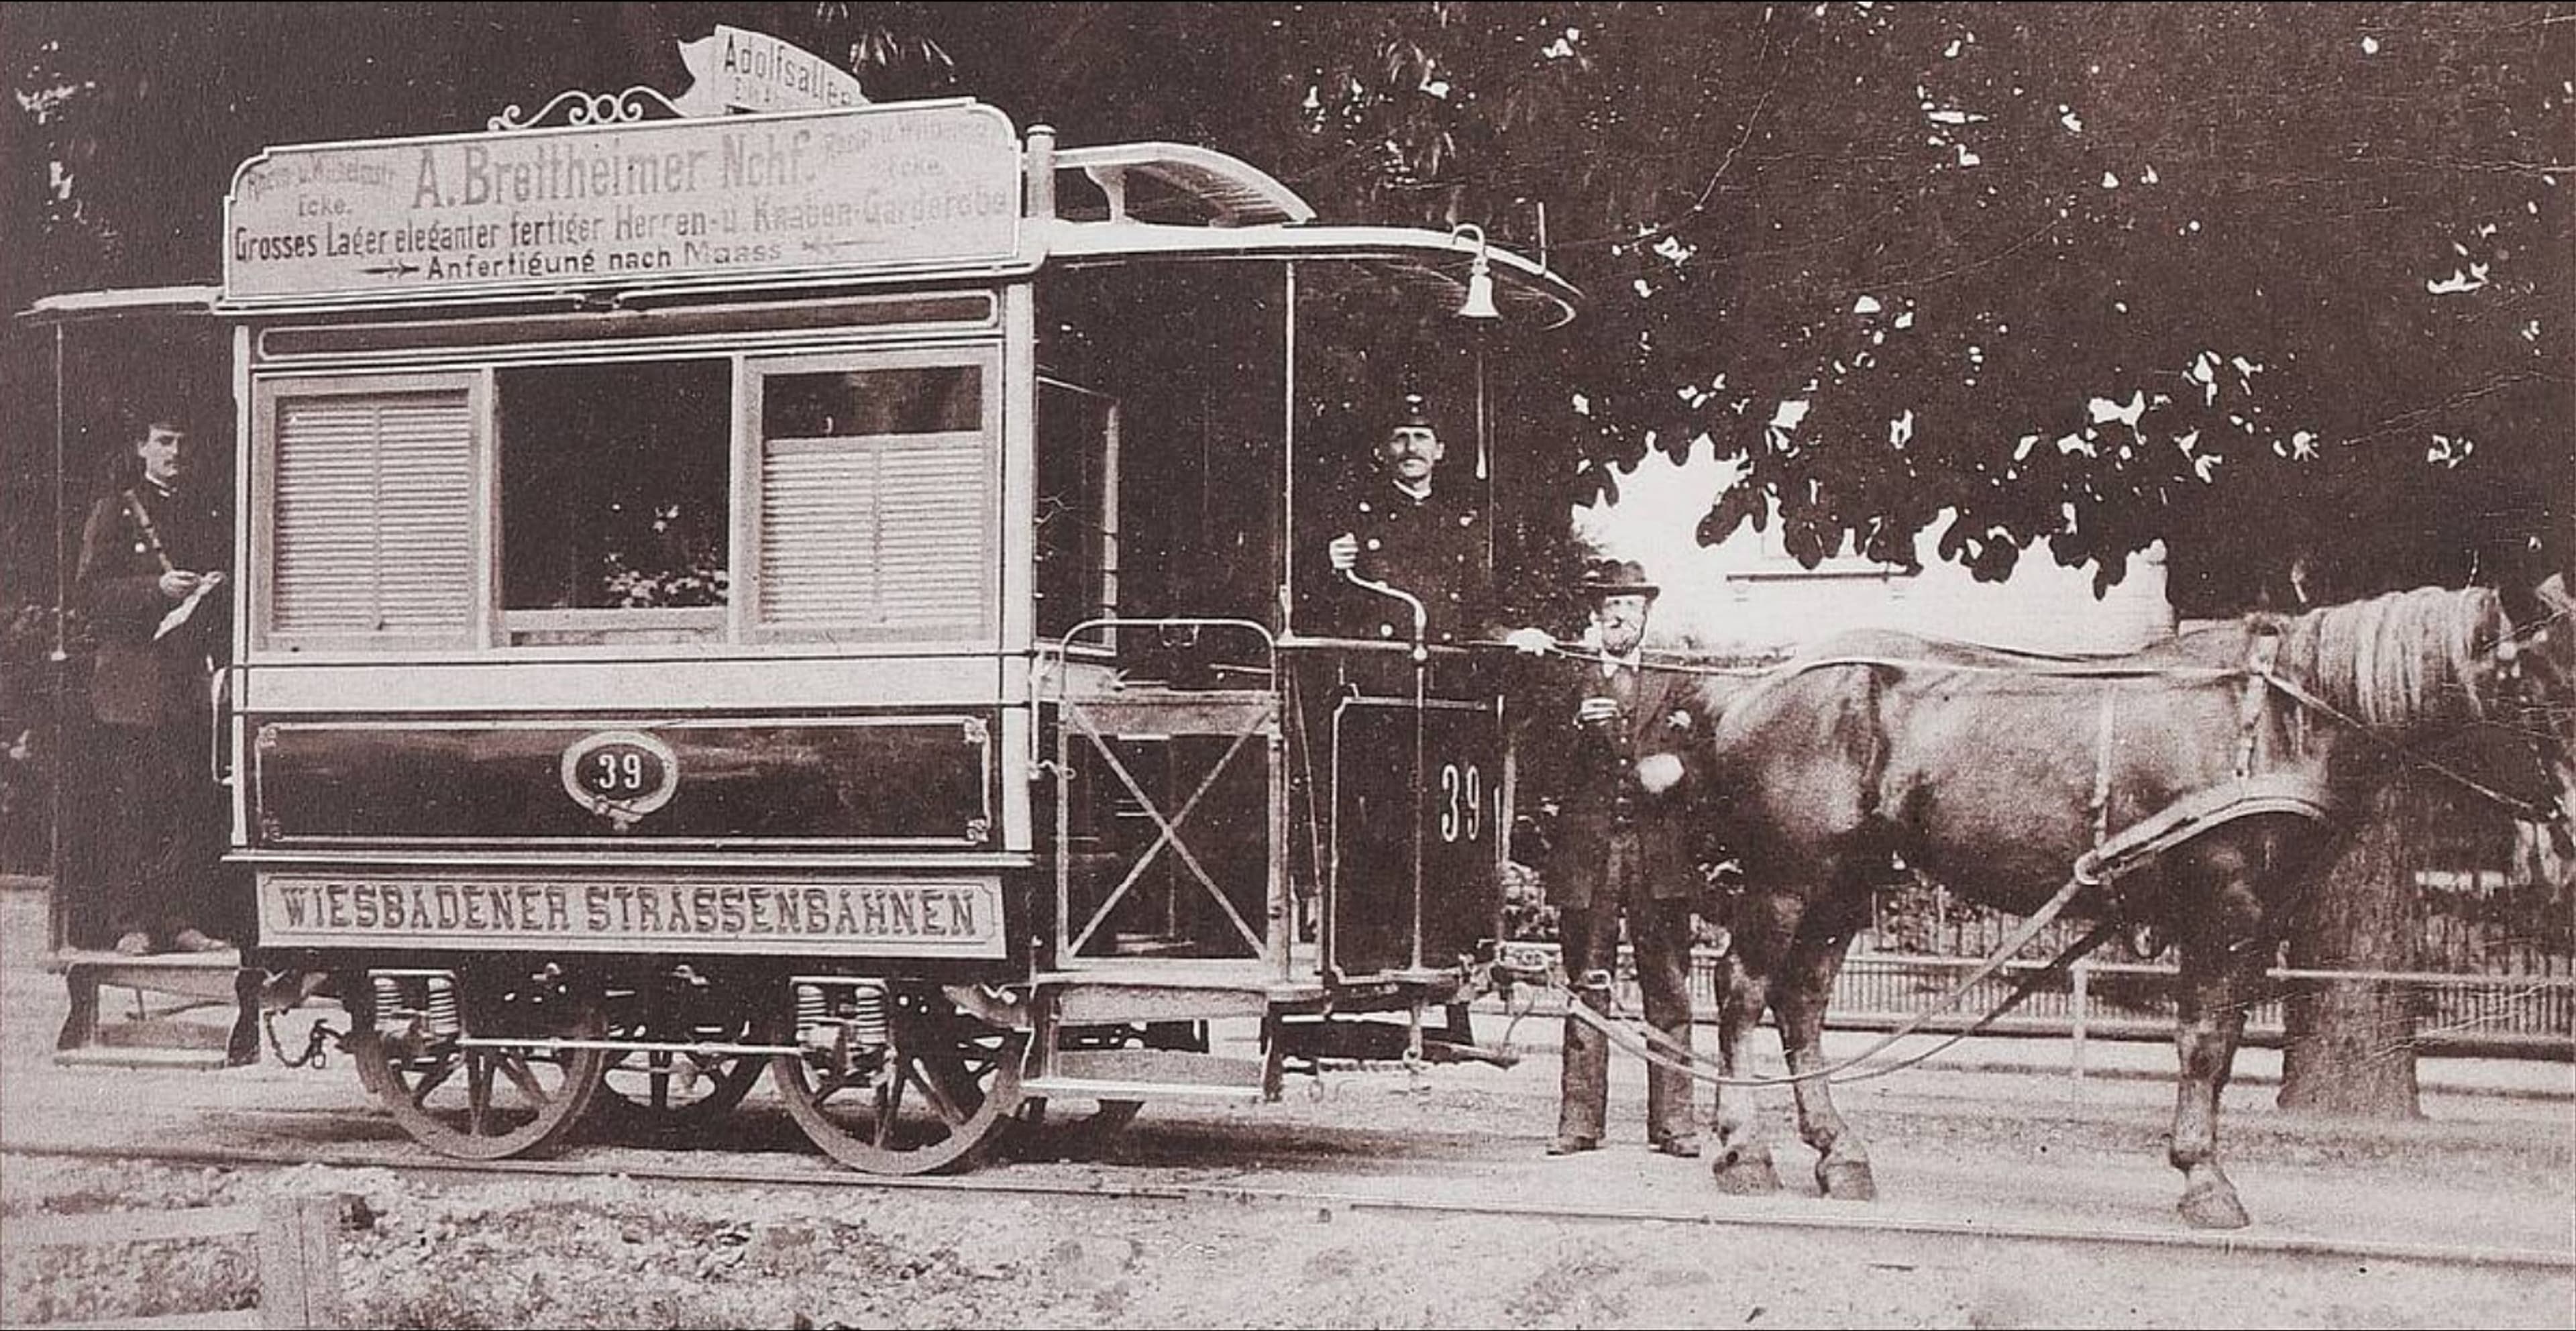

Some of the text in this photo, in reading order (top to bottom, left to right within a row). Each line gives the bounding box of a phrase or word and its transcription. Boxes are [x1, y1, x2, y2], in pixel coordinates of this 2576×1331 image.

[235, 226, 317, 261] Grosses
[326, 221, 390, 259] Lager
[394, 215, 500, 254] eleganter
[511, 210, 603, 248] fertiger
[427, 238, 782, 280] Anfertigung nach Maass
[599, 753, 643, 789] 39
[1442, 763, 1479, 843] 39
[280, 884, 976, 937] WIESBADENER STRASSENBAHNEN
